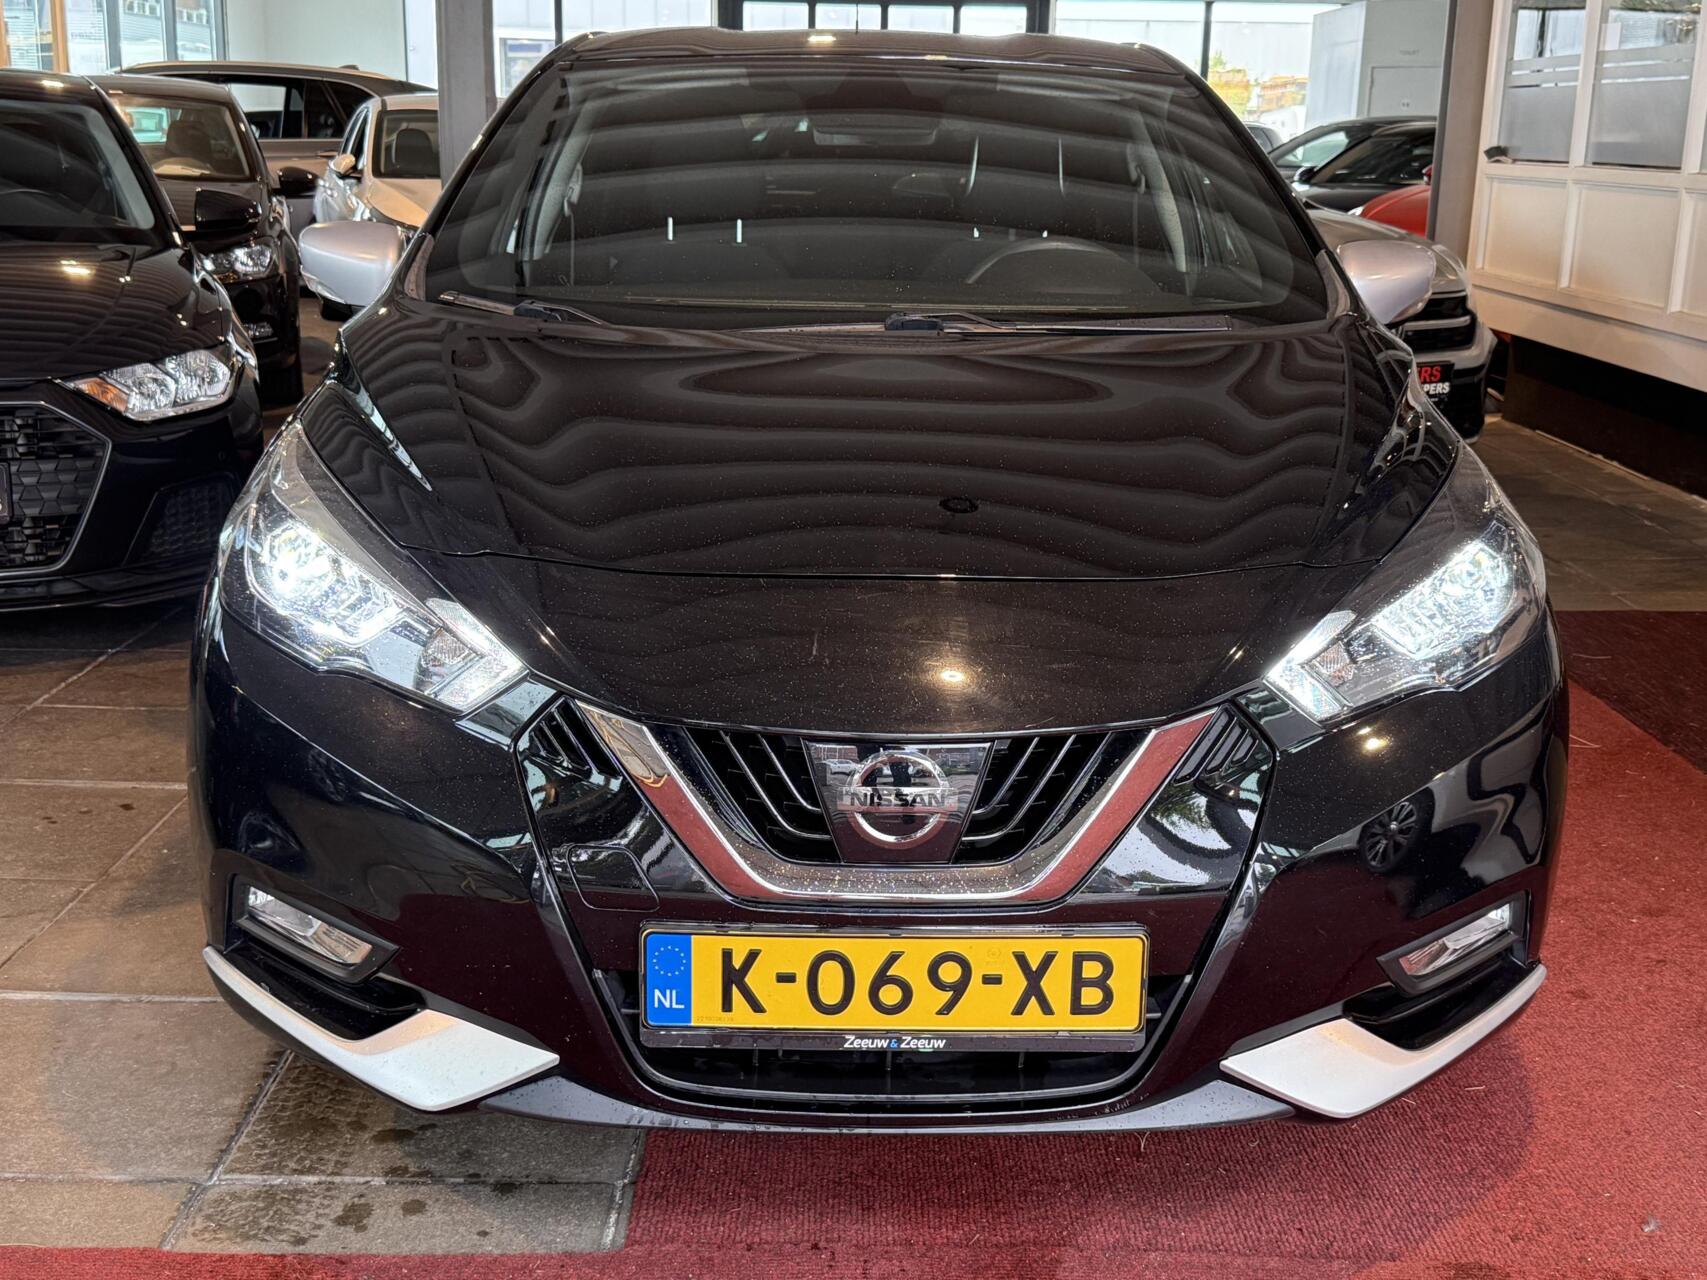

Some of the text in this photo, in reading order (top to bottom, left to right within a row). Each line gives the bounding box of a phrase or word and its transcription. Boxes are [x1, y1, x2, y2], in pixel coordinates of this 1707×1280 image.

[1418, 365, 1441, 382] RS
[1422, 382, 1450, 394] PERS
[850, 792, 946, 807] NISSAN
[721, 947, 1114, 1016] K-069-XB
[653, 988, 685, 1009] NL
[843, 1035, 946, 1048] Zeeuw & Zeeuw
